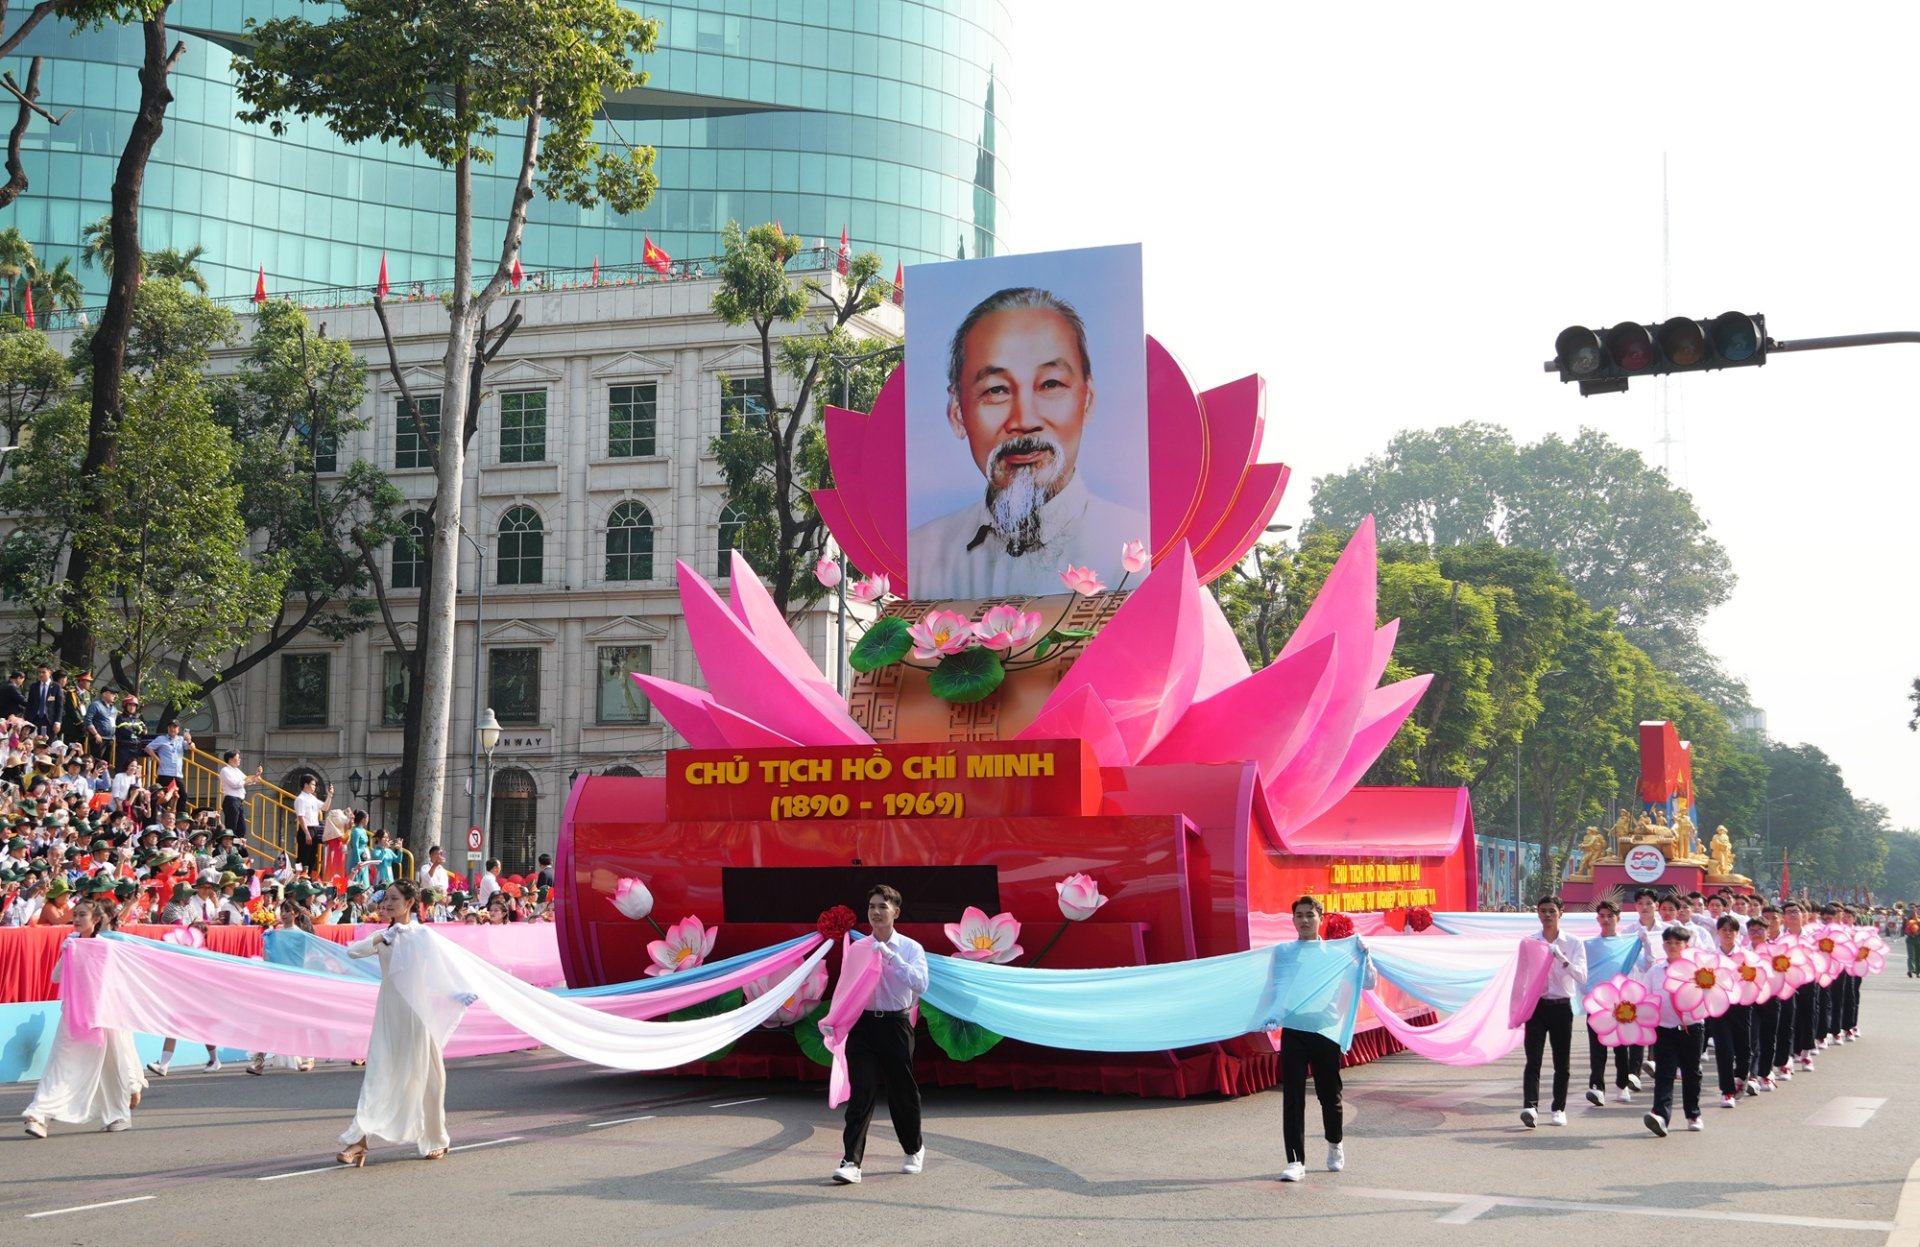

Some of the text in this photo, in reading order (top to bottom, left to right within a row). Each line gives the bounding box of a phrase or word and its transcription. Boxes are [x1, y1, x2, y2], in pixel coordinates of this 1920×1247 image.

[494, 738, 542, 747] UNWAY
[684, 748, 1055, 788] CHỦ TỊCH HỒ CHÍ MINH
[770, 792, 964, 821] (1890 - 1969)
